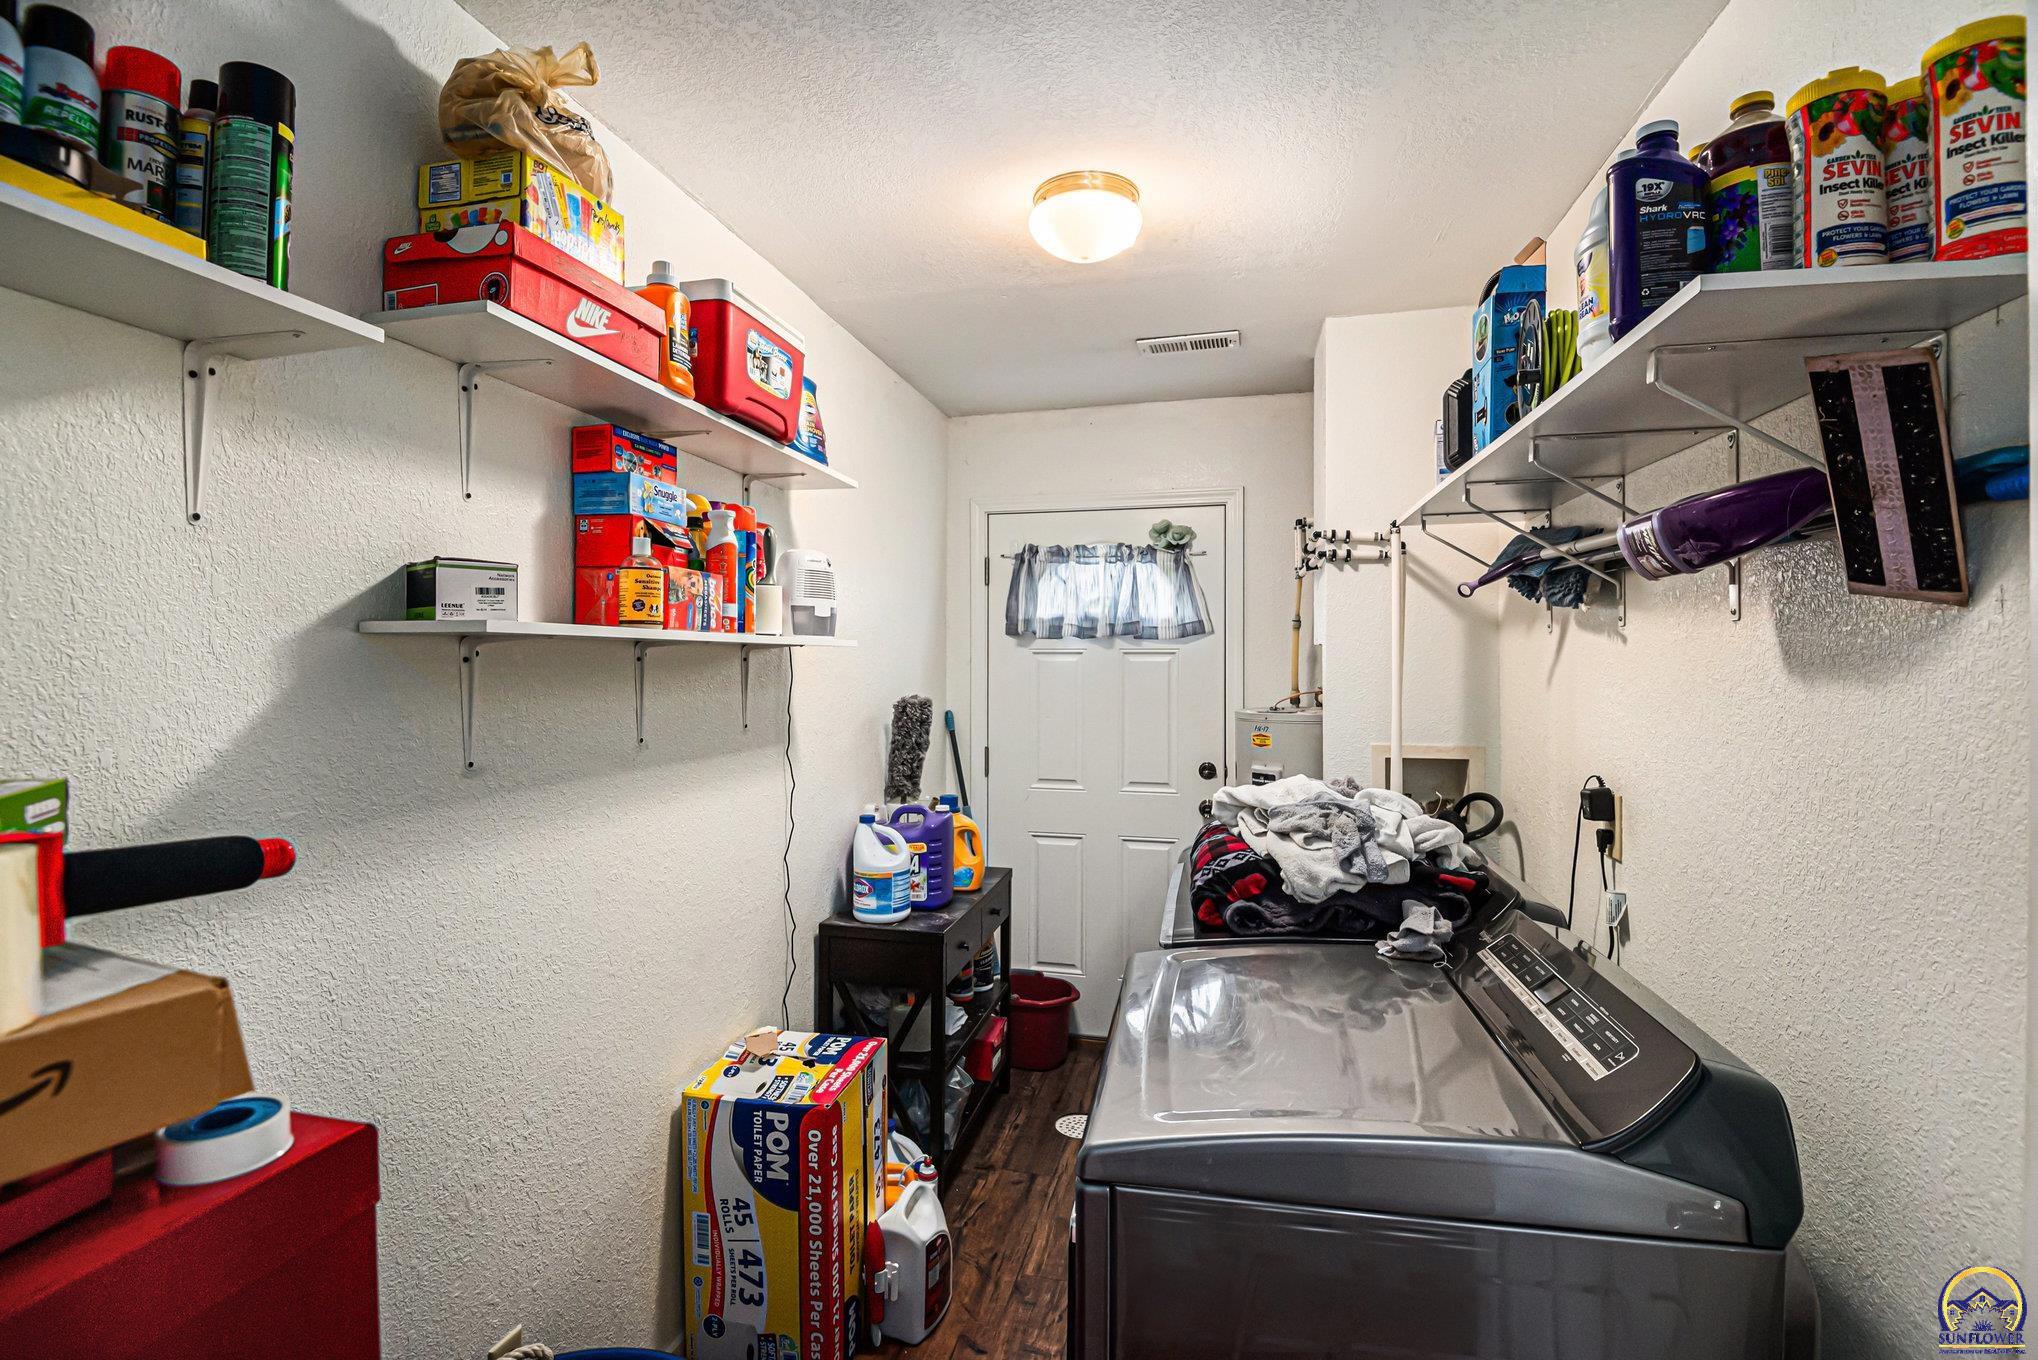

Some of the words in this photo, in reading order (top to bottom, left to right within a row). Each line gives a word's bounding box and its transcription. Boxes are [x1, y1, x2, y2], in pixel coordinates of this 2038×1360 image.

[1949, 112, 2021, 144] SEVIN
[1946, 137, 1987, 159] Insect
[1820, 178, 1860, 195] Insect
[1823, 160, 1881, 181] SEVIN
[1886, 184, 1911, 199] sect
[1640, 204, 1668, 215] Shark
[574, 297, 612, 330] NIKE
[653, 485, 678, 502] Snuggle
[822, 1037, 852, 1056] POM
[753, 1110, 763, 1149] TOILET
[766, 1111, 790, 1180] POM
[808, 1129, 822, 1170] Over
[753, 1149, 763, 1183] PAPER
[719, 1198, 734, 1234] ROLLS
[732, 1197, 754, 1227] 45
[805, 1174, 823, 1236] 21,000
[738, 1248, 764, 1307] 473
[809, 1240, 823, 1297] Sheets
[810, 1300, 823, 1329] Per
